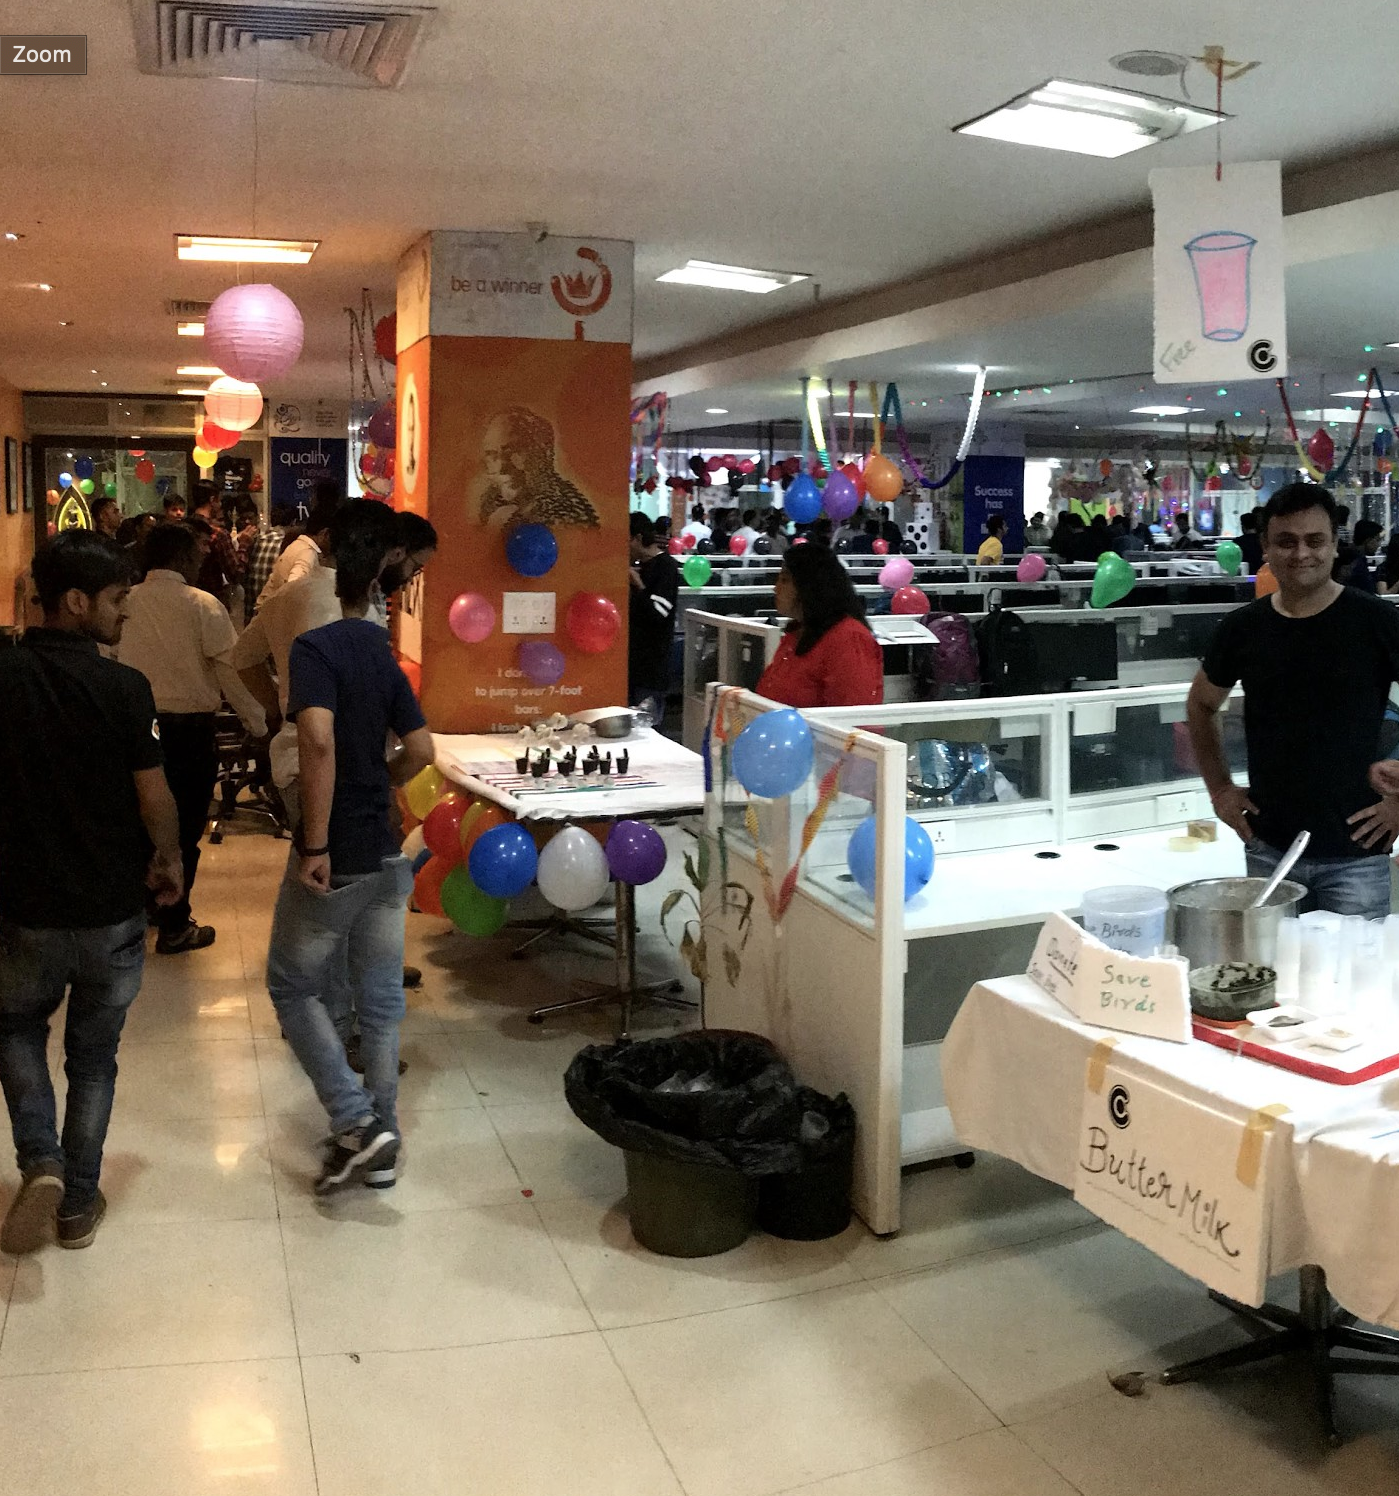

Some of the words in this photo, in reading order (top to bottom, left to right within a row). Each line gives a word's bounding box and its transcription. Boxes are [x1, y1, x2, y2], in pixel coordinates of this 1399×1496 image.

[451, 275, 470, 292] be
[476, 279, 486, 292] a
[491, 277, 543, 294] winner
[280, 448, 331, 467] quality
[974, 485, 1014, 496] Success
[985, 498, 1003, 508] has
[475, 686, 487, 696] to
[489, 686, 518, 698] jump
[549, 685, 582, 696] 7-foot
[1101, 922, 1142, 939] Birds
[1101, 965, 1151, 988] Save
[1100, 991, 1156, 1014] Birds
[1080, 1126, 1176, 1208] Butter
[1178, 1182, 1240, 1257] Milk
